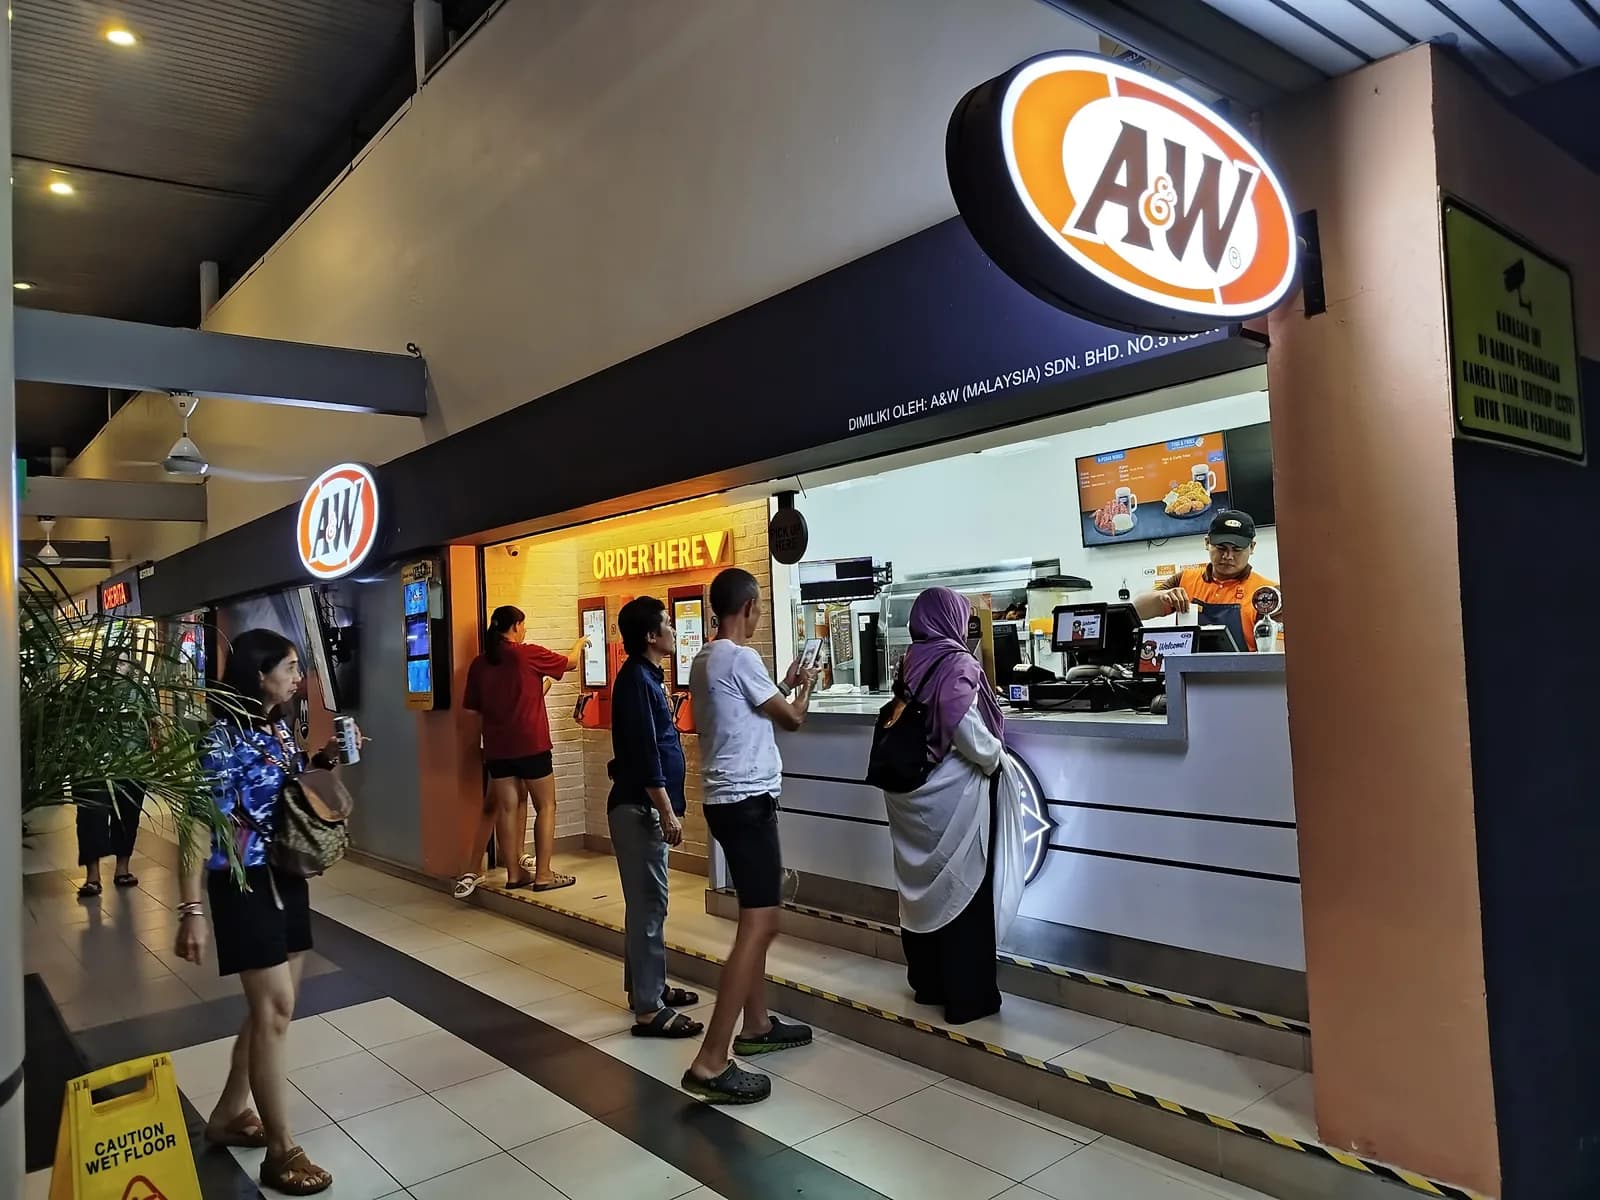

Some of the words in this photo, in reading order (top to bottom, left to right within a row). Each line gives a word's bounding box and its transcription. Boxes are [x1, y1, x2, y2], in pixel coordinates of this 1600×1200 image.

[848, 408, 890, 431] DIMILIKI
[892, 398, 928, 419] OLEH:
[930, 387, 959, 409] A&W
[962, 365, 1041, 402] (MALAYSIA)
[1044, 355, 1081, 378] SDN.
[1085, 343, 1124, 367] BHD.
[312, 482, 362, 558] A&W
[593, 544, 650, 580] ORDER
[653, 534, 705, 572] HERE
[1159, 639, 1188, 651] Welcome!
[86, 1153, 120, 1175] WET
[124, 1134, 176, 1163] FLOOR
[95, 1122, 164, 1156] CAUTION
